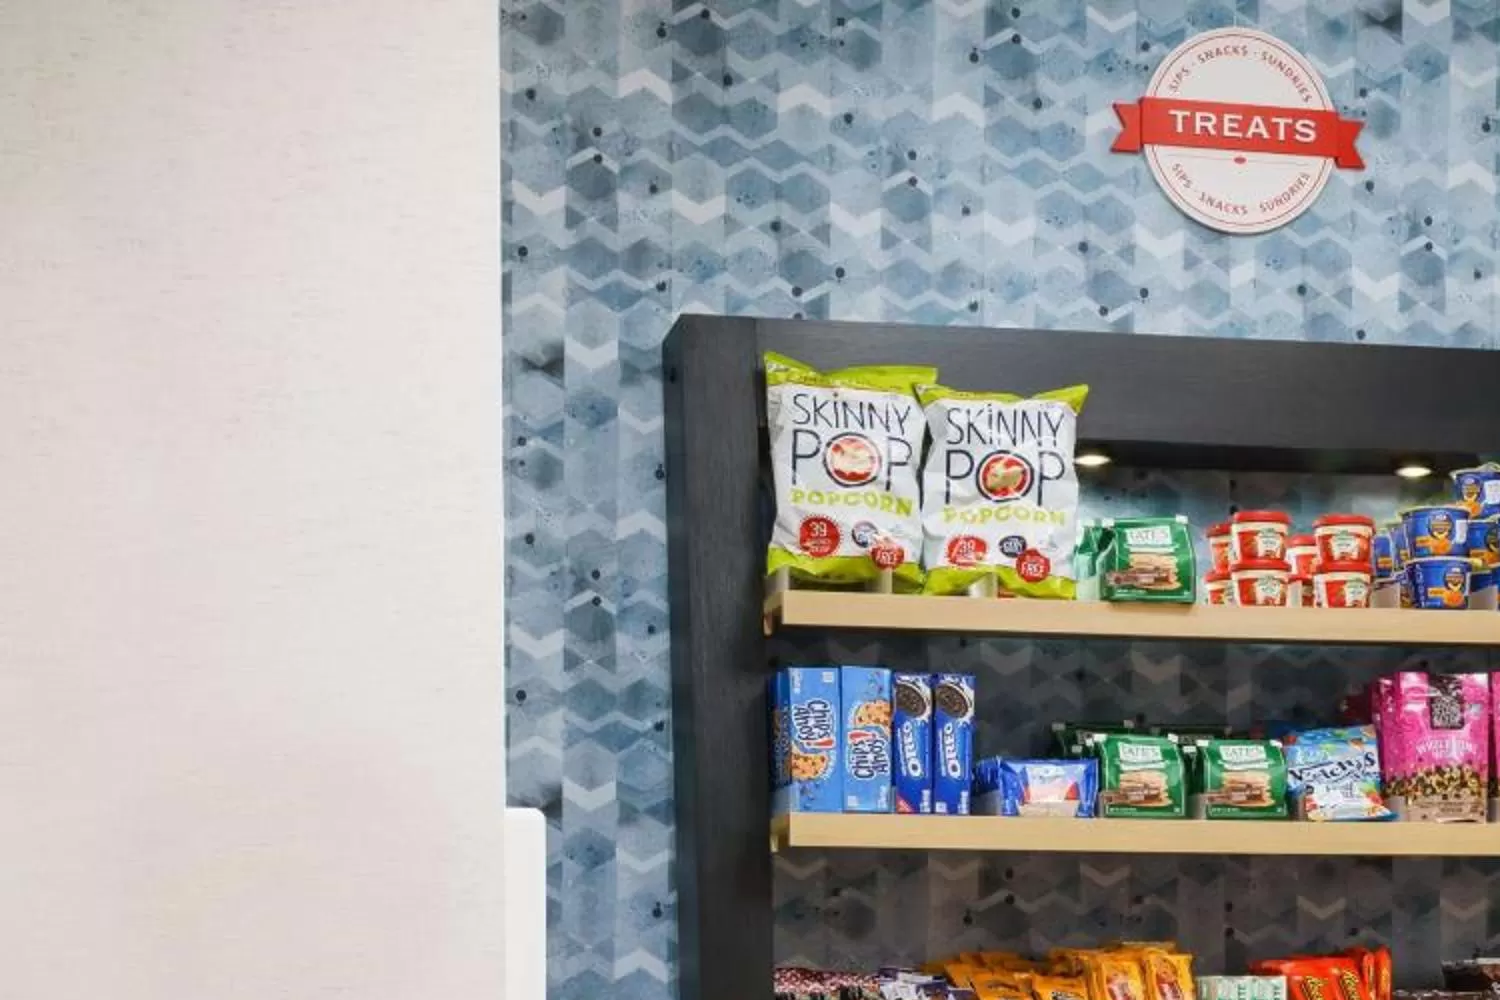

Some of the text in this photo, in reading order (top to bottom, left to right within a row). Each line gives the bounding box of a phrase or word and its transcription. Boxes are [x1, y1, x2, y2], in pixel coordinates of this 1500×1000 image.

[1168, 44, 1313, 104] SIPS SNACKS SUNDRIES
[1168, 108, 1318, 144] TREATS
[1171, 163, 1192, 190] SIPS
[1199, 191, 1249, 217] SNACKS
[791, 429, 914, 492] POP
[944, 449, 1067, 507] POP
[789, 487, 914, 518] POPCORN
[943, 507, 1068, 527] POPCORN
[807, 700, 829, 742] Chips
[853, 741, 875, 779] Chips
[902, 721, 921, 778] OREO
[944, 722, 961, 779] OREO
